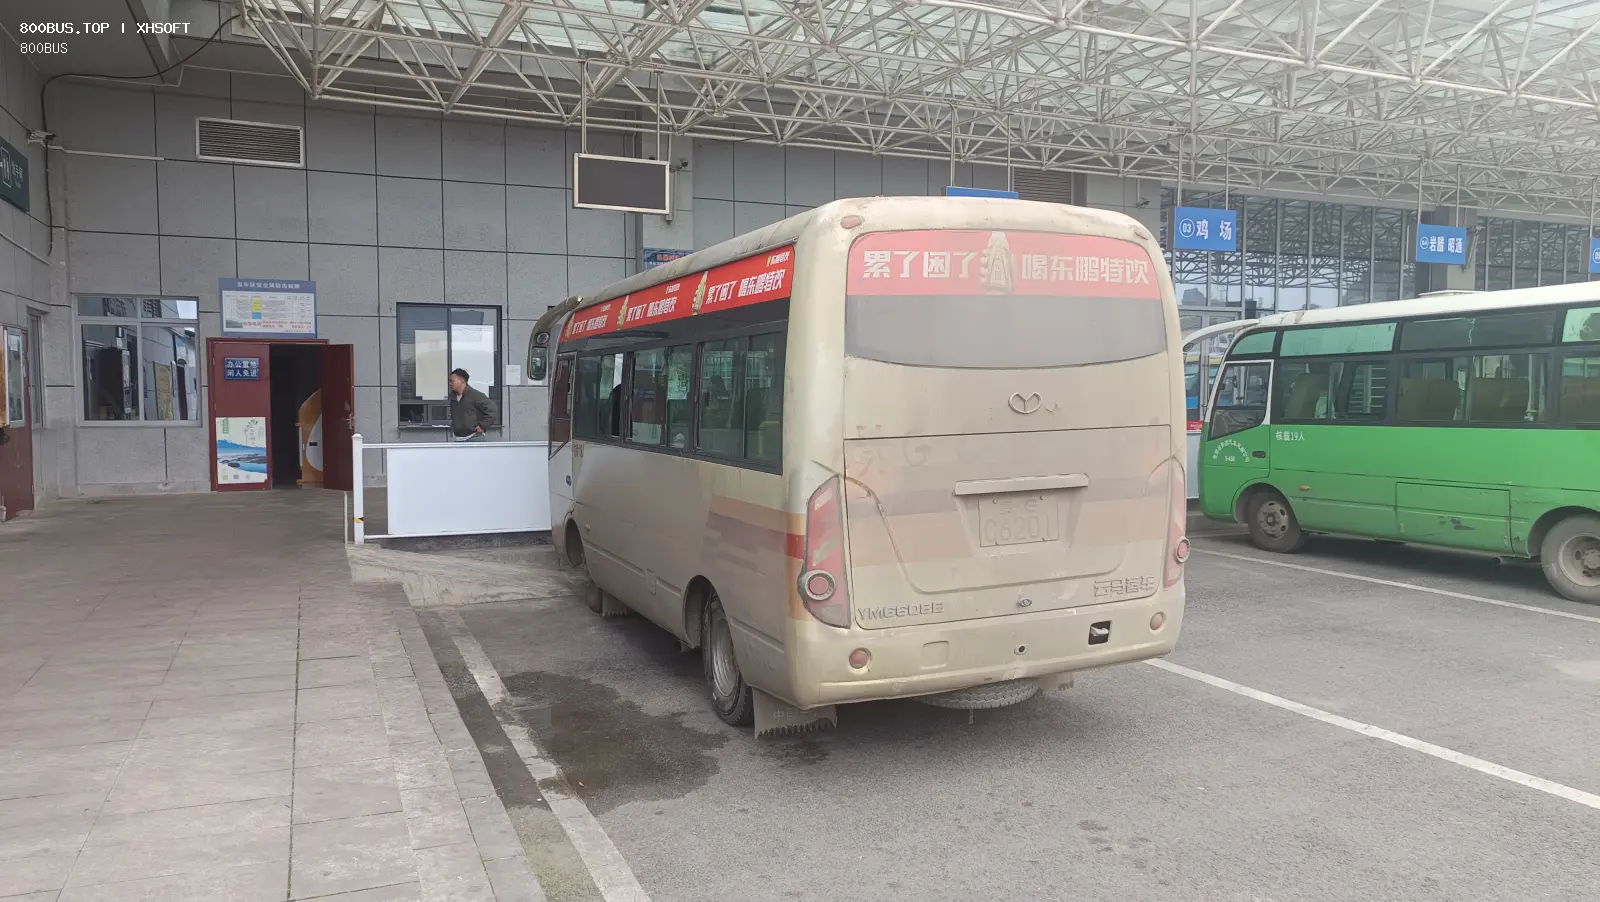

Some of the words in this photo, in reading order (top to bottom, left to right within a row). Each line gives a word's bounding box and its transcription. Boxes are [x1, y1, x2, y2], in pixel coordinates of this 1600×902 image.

[1196, 219, 1232, 240] 鸡场
[863, 250, 978, 279] 累了困了
[1021, 253, 1150, 285] 喝东鹏特饮
[706, 280, 737, 304] 累了困了
[737, 269, 786, 298] 喝东鹏特饮
[227, 360, 258, 369] 办公重地
[1275, 430, 1305, 441] 核载19人
